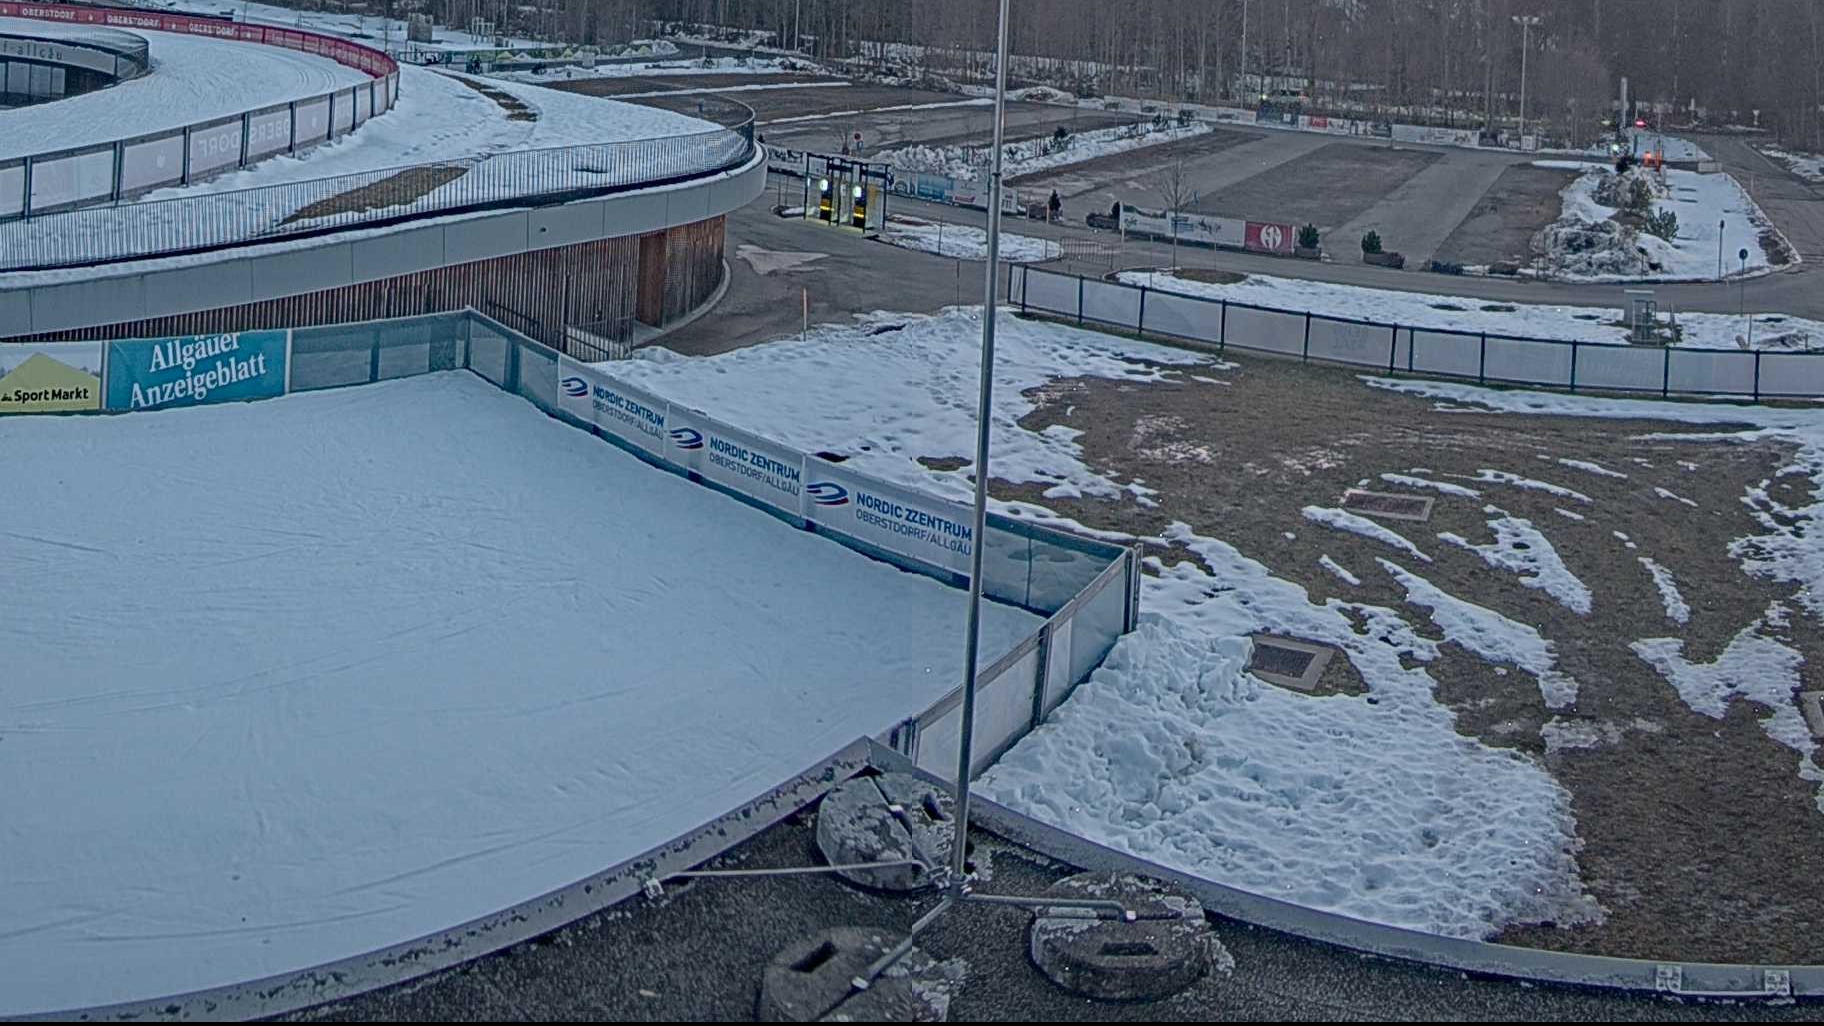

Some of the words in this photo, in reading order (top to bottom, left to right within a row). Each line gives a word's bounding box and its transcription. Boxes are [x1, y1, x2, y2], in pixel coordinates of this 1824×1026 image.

[22, 7, 75, 19] OBERSTDORF
[107, 14, 159, 27] OBERSTDORF
[149, 333, 240, 370] Allgäuer
[14, 389, 50, 404] Sport
[51, 387, 89, 400] Markt
[130, 352, 266, 408] Anzeigeblatt
[592, 384, 624, 408] NORDIC
[625, 400, 664, 427] ZENTRUM
[710, 437, 748, 462] NORDIC
[750, 452, 800, 482] ZENTRUM
[856, 492, 902, 518] NORDIC
